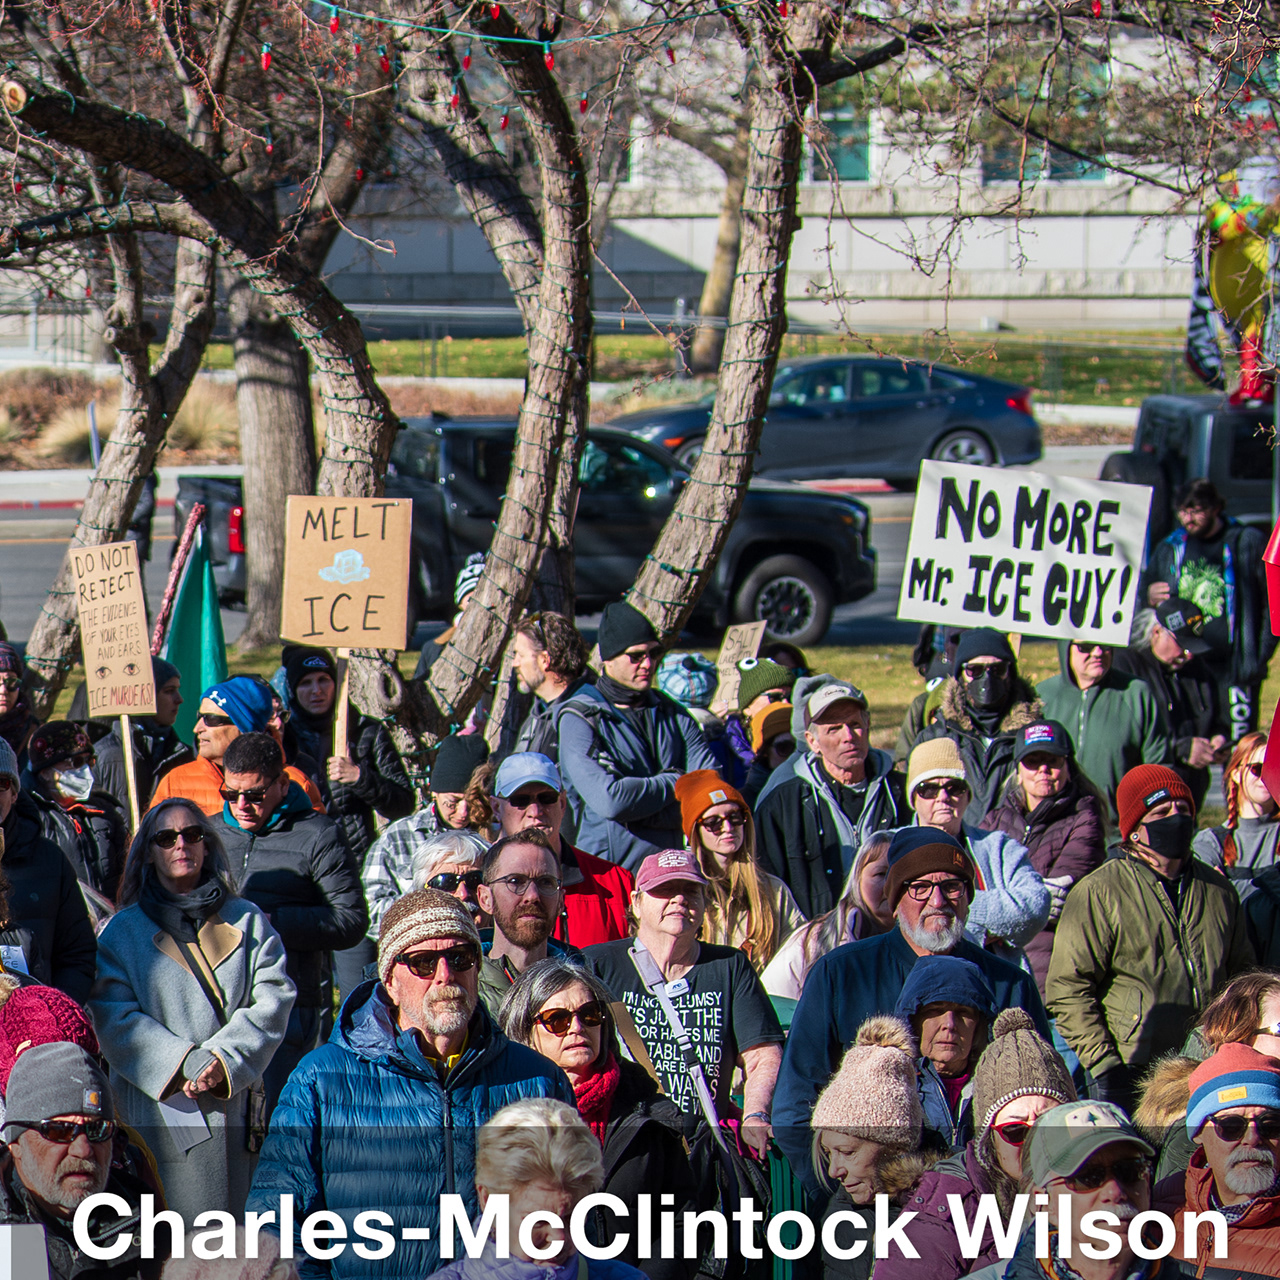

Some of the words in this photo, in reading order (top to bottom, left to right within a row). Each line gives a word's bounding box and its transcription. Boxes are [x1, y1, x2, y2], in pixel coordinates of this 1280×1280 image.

[302, 503, 399, 541] MELT
[935, 477, 1002, 543] NO
[1013, 486, 1121, 556] MORE
[75, 553, 95, 579] DO
[101, 545, 131, 571] NOT
[79, 571, 134, 606] REJECT
[908, 557, 954, 606] Mr.
[963, 555, 1034, 622] ICE
[1043, 562, 1133, 629] GUY!
[81, 607, 98, 629] THE
[302, 593, 385, 637] ICE
[84, 631, 96, 645] OF
[100, 627, 118, 645] YOUR
[120, 622, 140, 639] EYES
[726, 627, 759, 650] SALT
[98, 645, 115, 661] AND
[118, 640, 142, 658] EARS
[90, 687, 107, 711] ICE
[110, 683, 154, 707] MURDERS!
[622, 991, 639, 1006] I'M
[693, 1008, 723, 1027] THE
[655, 1061, 677, 1072] ARE
